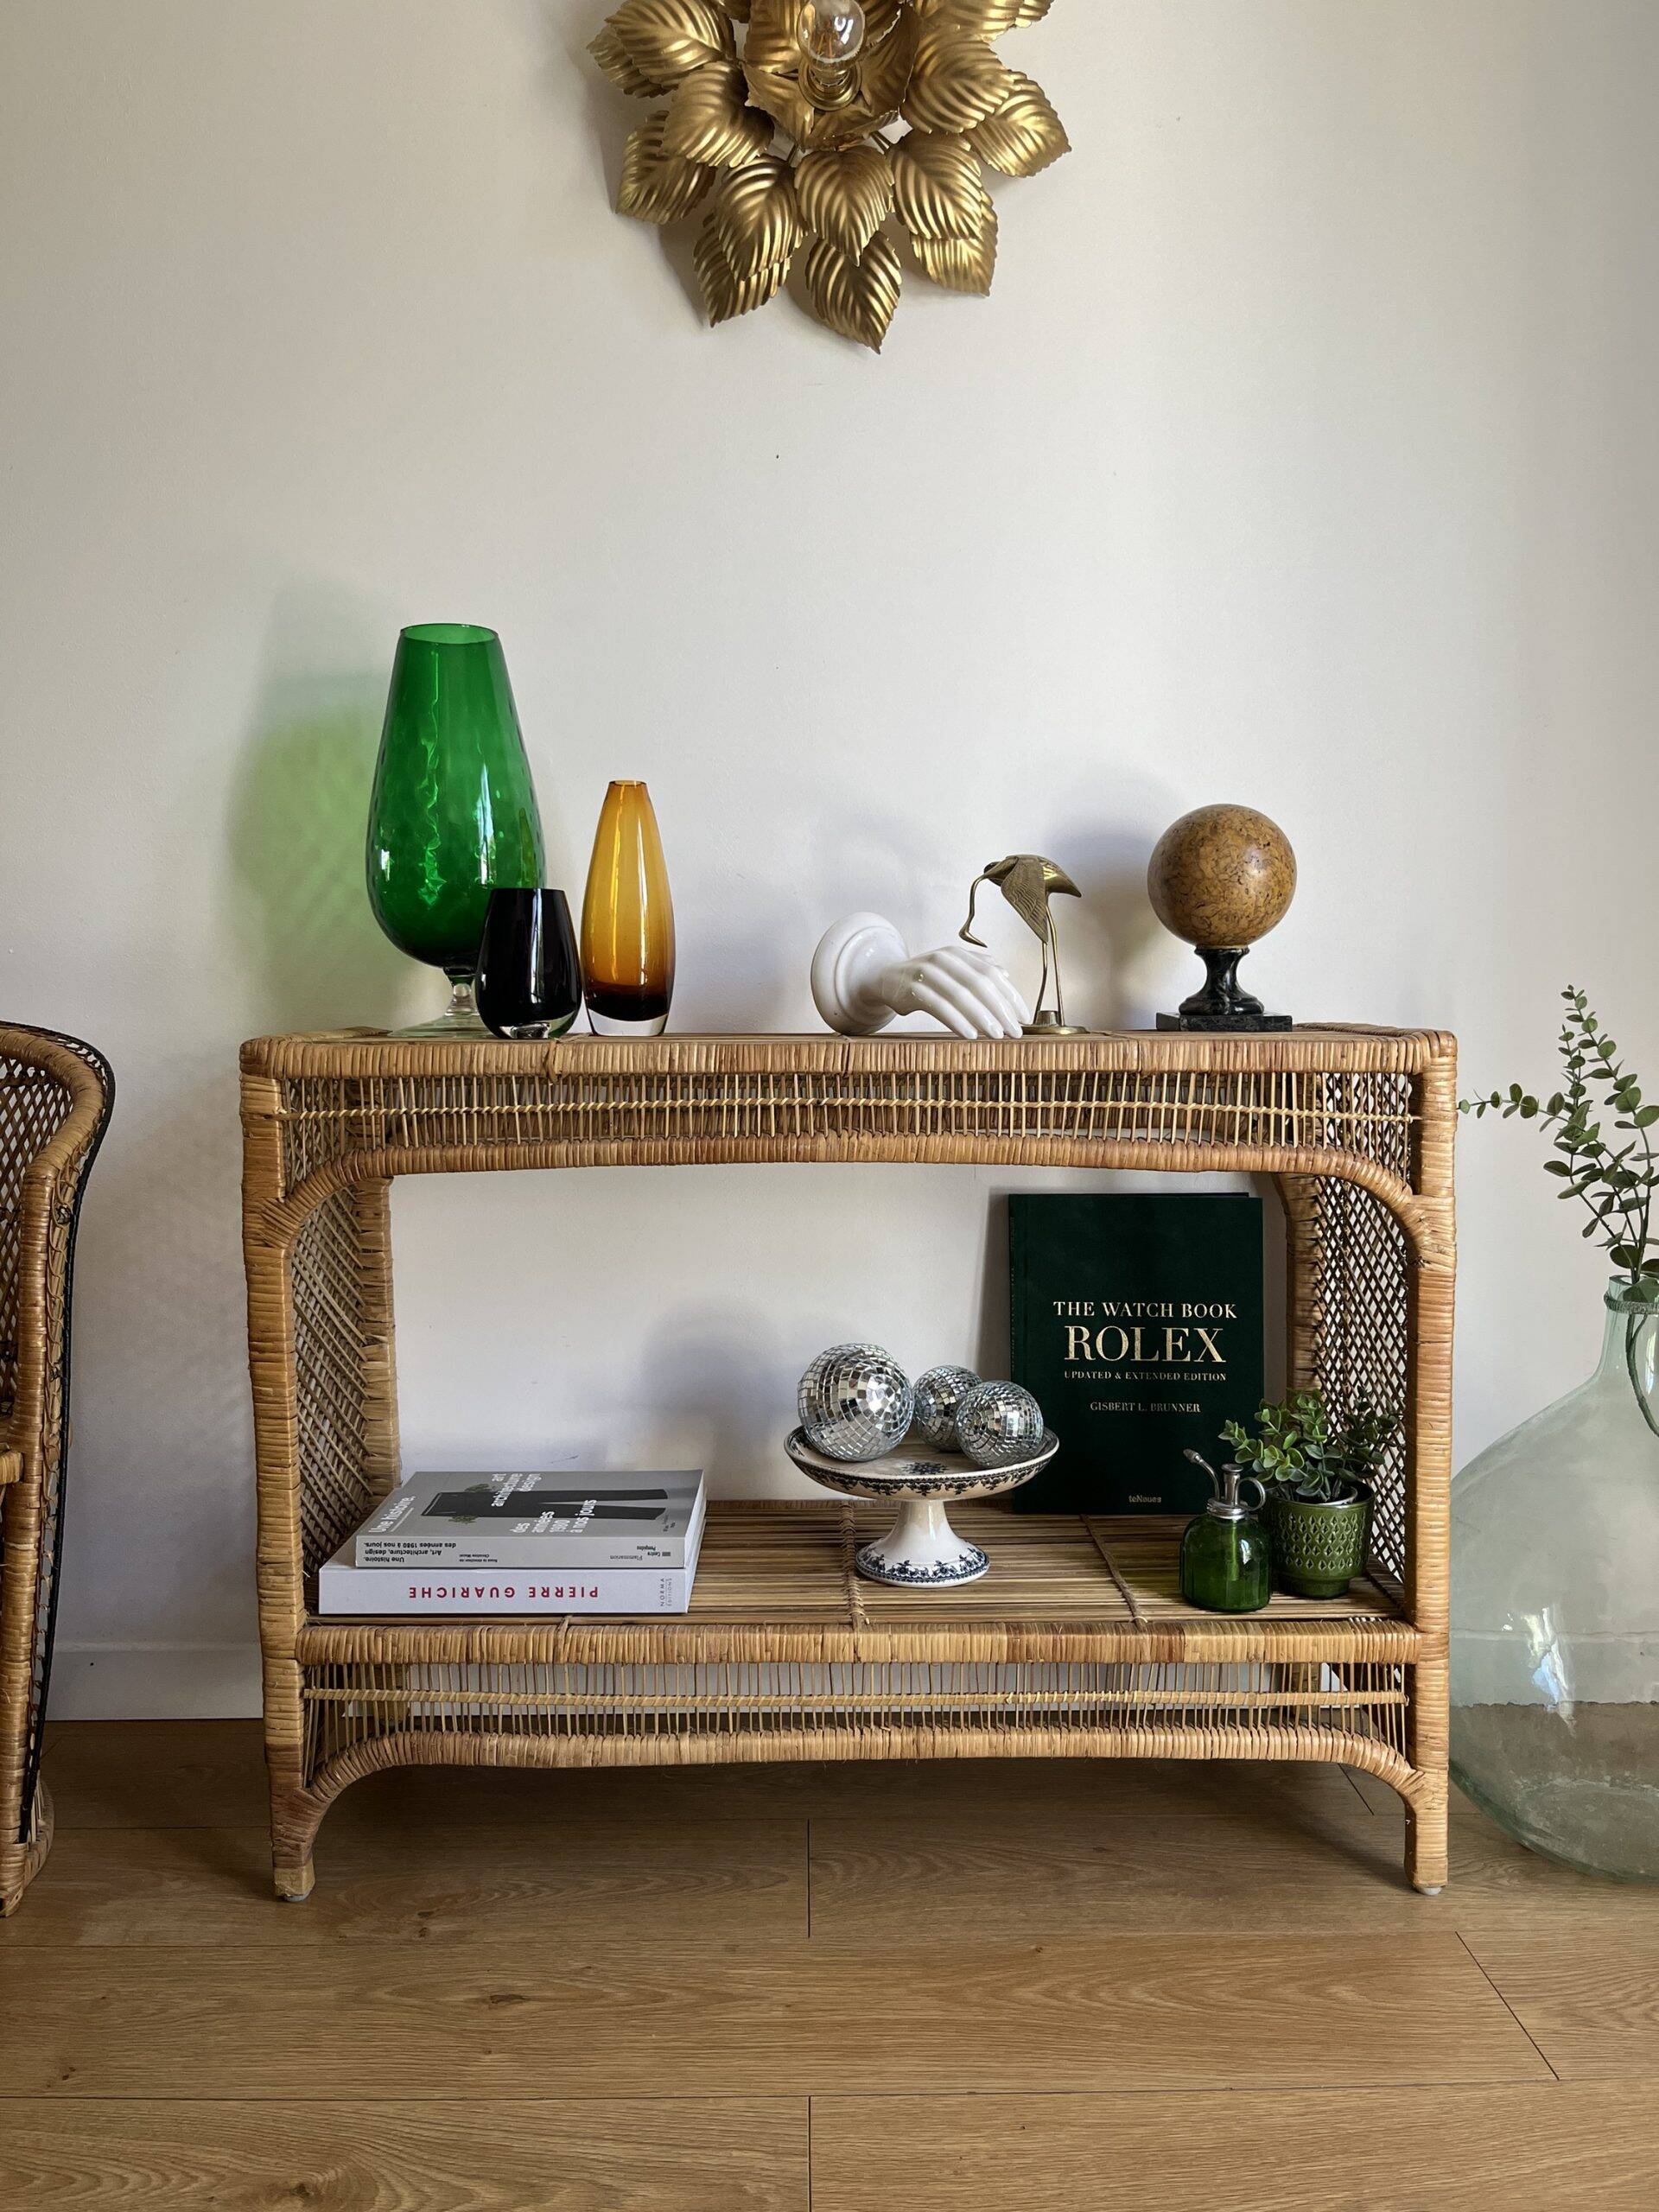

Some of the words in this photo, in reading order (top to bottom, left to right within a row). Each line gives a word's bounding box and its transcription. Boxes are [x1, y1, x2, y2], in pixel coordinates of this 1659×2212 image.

[1053, 1301, 1095, 1317] THE
[1102, 1301, 1173, 1318] WATCH
[1181, 1303, 1237, 1319] BOOK
[1064, 1325, 1226, 1363] ROLEX
[1065, 1370, 1111, 1380] UPDATED
[1125, 1371, 1180, 1381] EXTENDED
[1184, 1372, 1226, 1381] EDITION
[1090, 1402, 1135, 1412] GISBERT
[1138, 1402, 1147, 1412] L.
[1150, 1402, 1201, 1413] BRUNNER
[409, 1586, 515, 1599] GUARICHE
[529, 1586, 598, 1598] PIERRE
